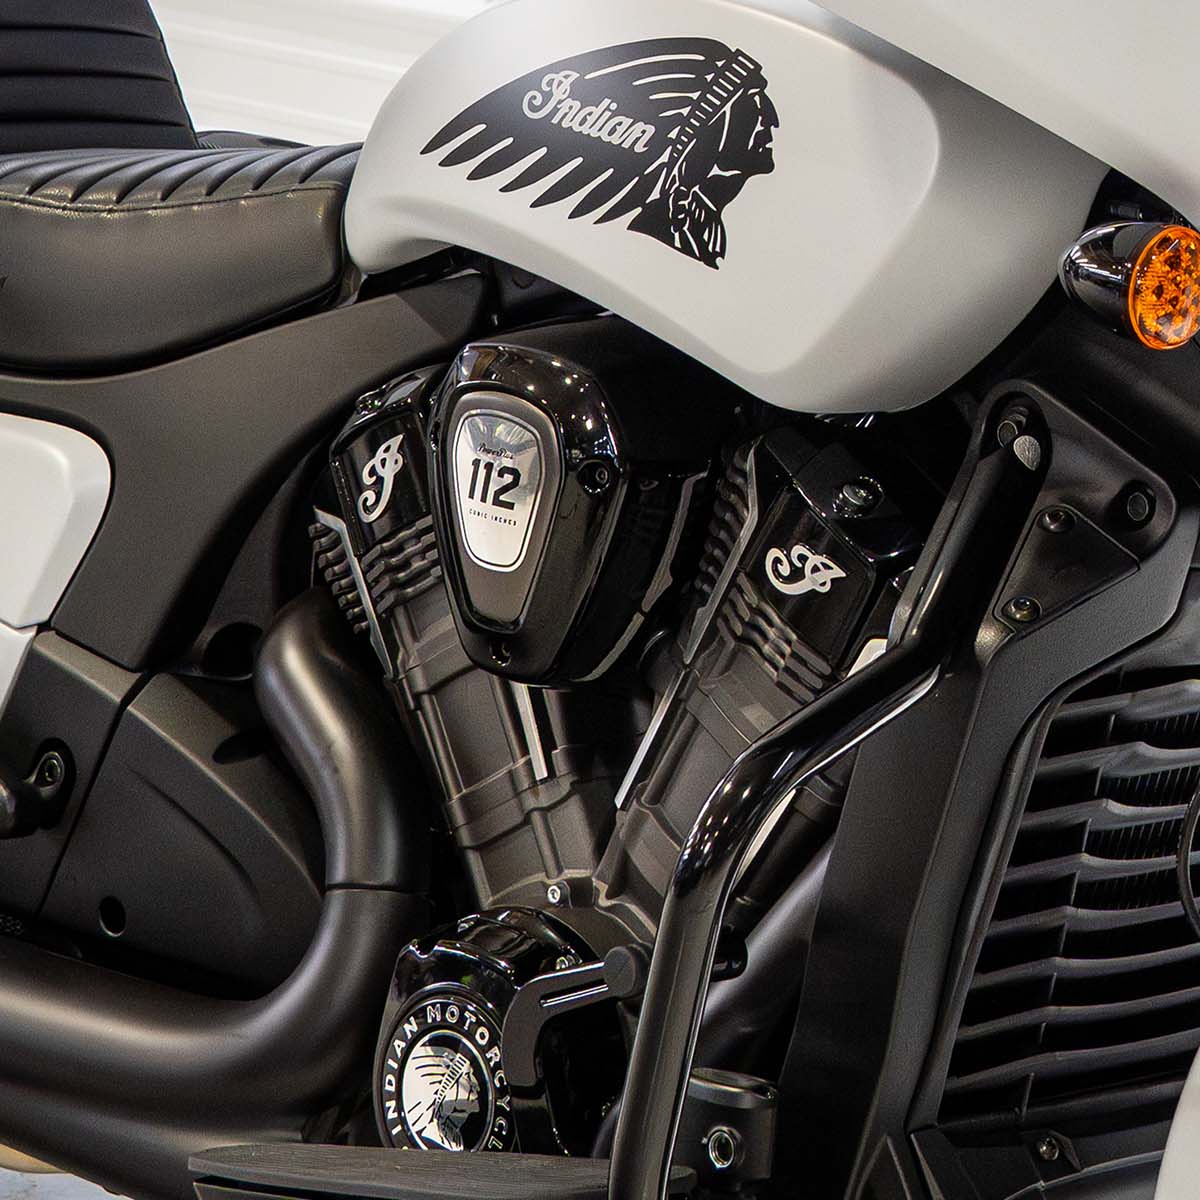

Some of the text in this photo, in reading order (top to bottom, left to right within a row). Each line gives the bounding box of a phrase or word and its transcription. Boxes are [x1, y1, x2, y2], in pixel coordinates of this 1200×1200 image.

[522, 70, 656, 153] Indian
[468, 457, 522, 511] 112
[468, 508, 517, 527] CUBIC INCHES
[384, 1015, 419, 1136] INDIAN
